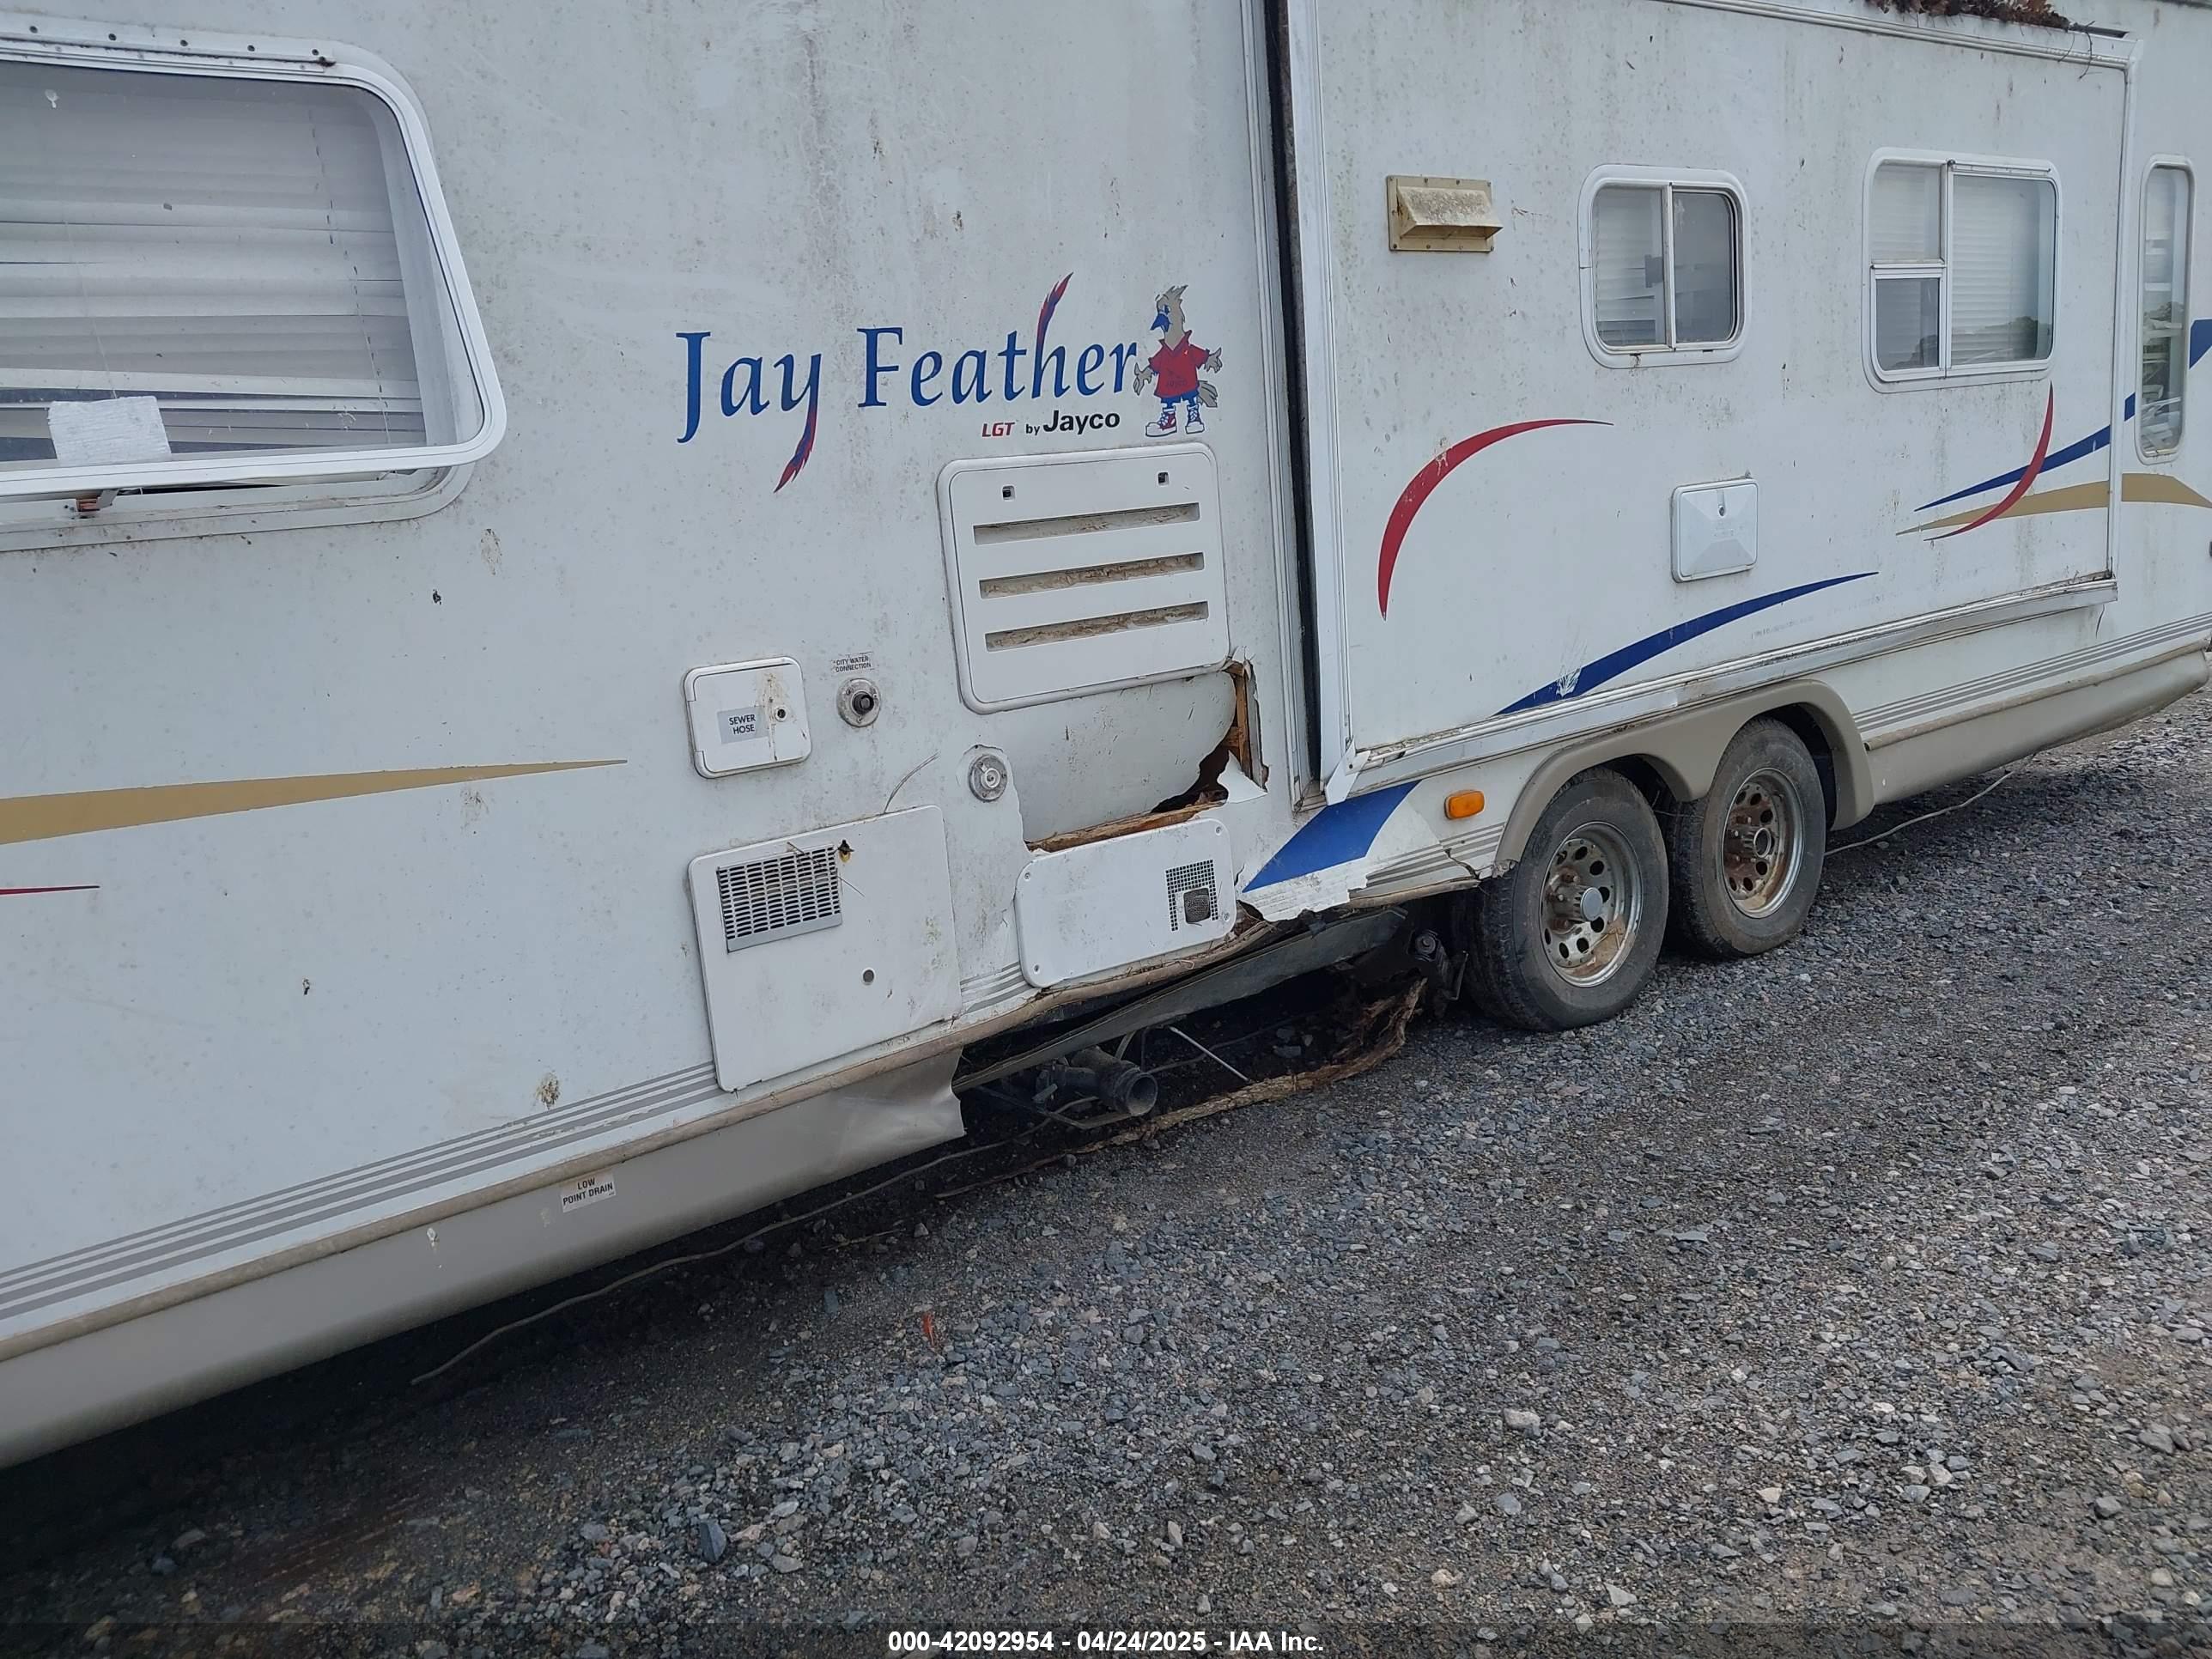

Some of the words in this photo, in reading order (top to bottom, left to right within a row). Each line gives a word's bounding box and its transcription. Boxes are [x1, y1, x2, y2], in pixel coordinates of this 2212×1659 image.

[677, 331, 822, 494] Jay
[857, 272, 1137, 407] Feather
[981, 422, 1016, 438] LGT
[1025, 423, 1040, 436] by
[1042, 410, 1120, 435] Jayco
[849, 655, 869, 664] WATER
[835, 662, 872, 673] CONNECTION
[728, 714, 756, 726] SEWER
[732, 724, 756, 735] HOSE
[577, 1177, 596, 1190] LOW
[562, 1191, 586, 1206] POINT
[588, 1182, 614, 1198] DRAIN
